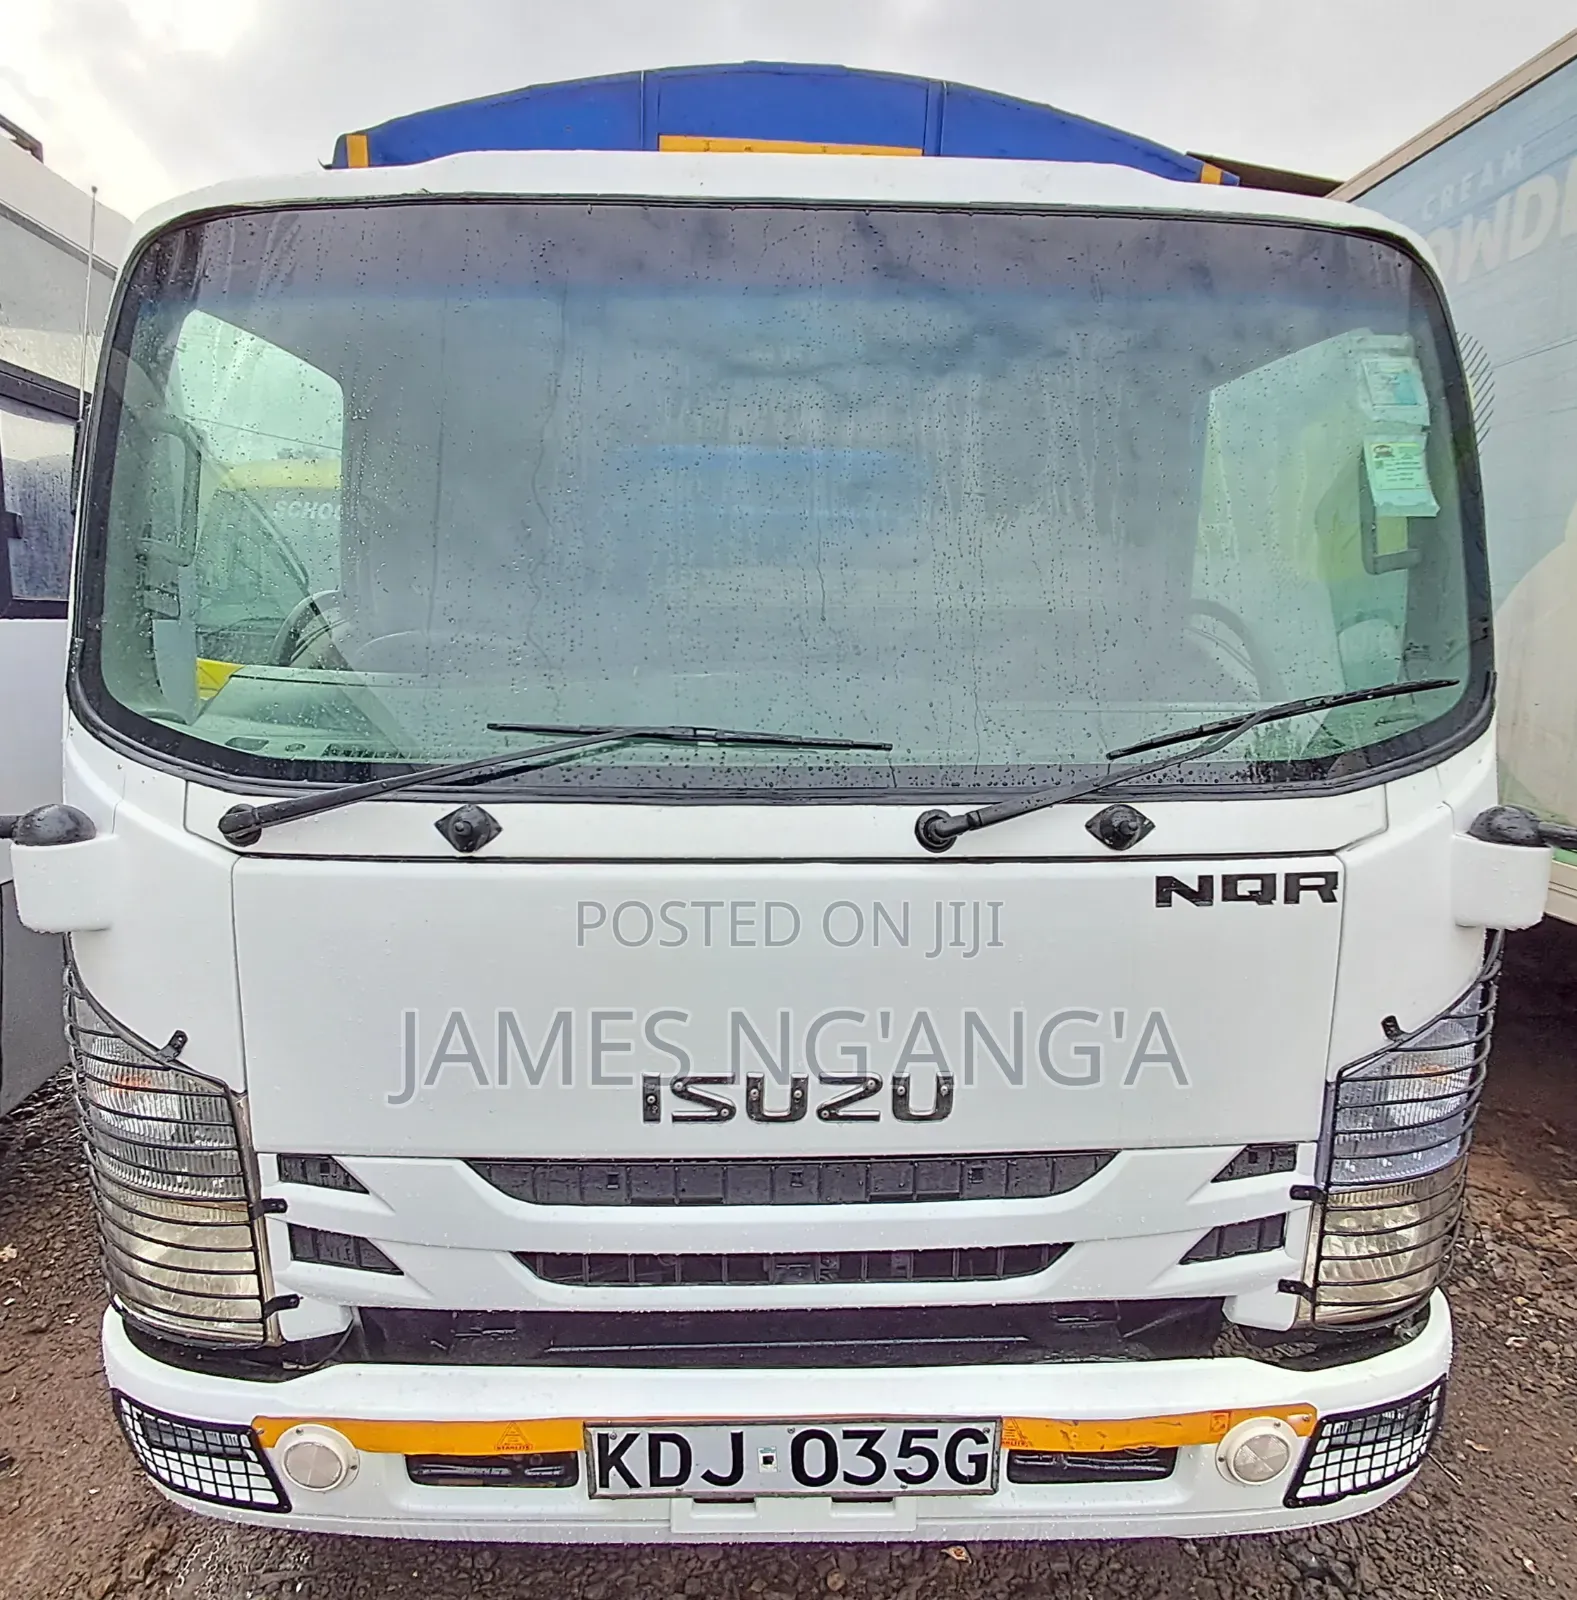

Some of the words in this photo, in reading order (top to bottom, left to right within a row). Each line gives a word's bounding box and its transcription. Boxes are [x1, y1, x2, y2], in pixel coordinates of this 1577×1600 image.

[1421, 145, 1524, 221] CREAM
[1155, 871, 1338, 908] NQR
[642, 1072, 955, 1124] ISUZU
[597, 1431, 744, 1489] KDJ
[790, 1427, 990, 1488] 035G
